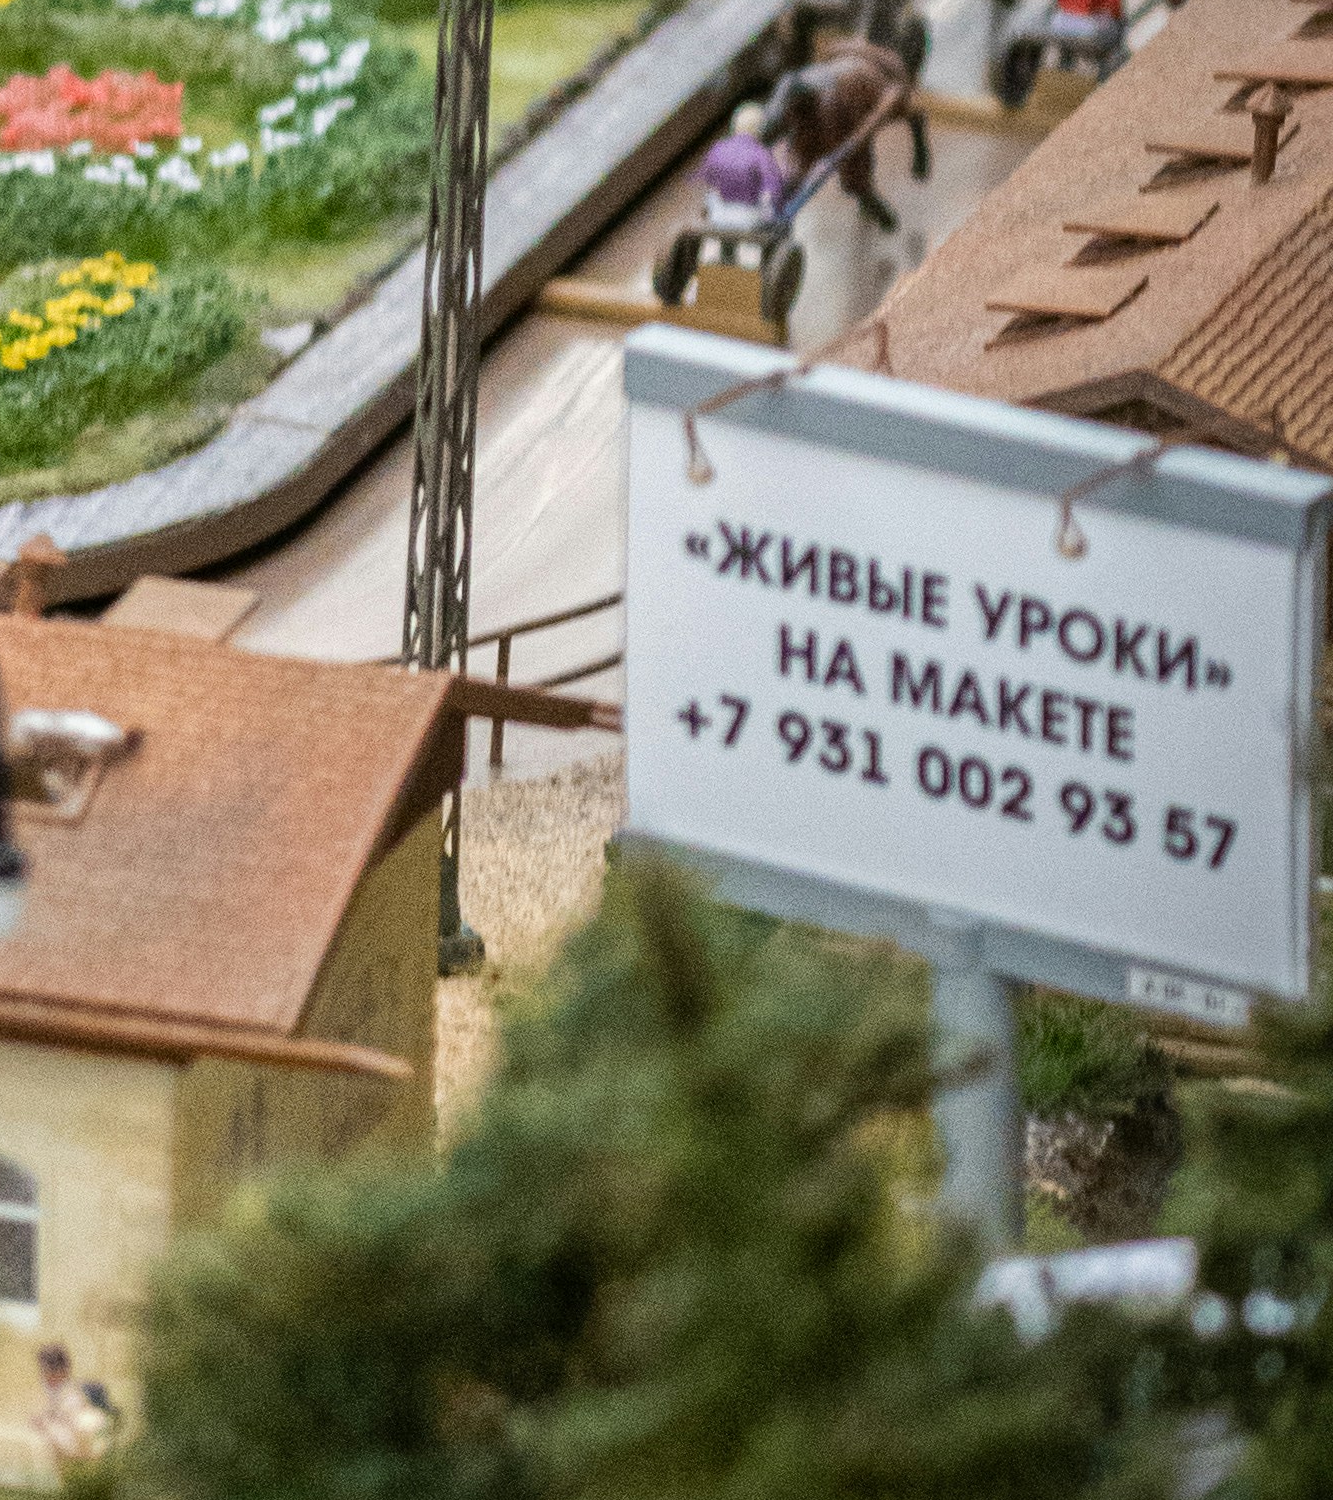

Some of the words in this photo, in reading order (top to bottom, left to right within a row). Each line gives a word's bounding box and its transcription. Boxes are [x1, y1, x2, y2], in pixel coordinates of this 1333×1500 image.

[683, 519, 949, 629] «ЖИВЫЕ
[973, 582, 1233, 692] УРОКИ»
[776, 623, 865, 696] НА
[889, 652, 1134, 763] МАКЕТЕ
[675, 692, 751, 749] +7
[774, 709, 890, 787] 931
[914, 745, 1034, 824] 002
[1056, 780, 1139, 848] 93
[1162, 804, 1239, 871] 57
